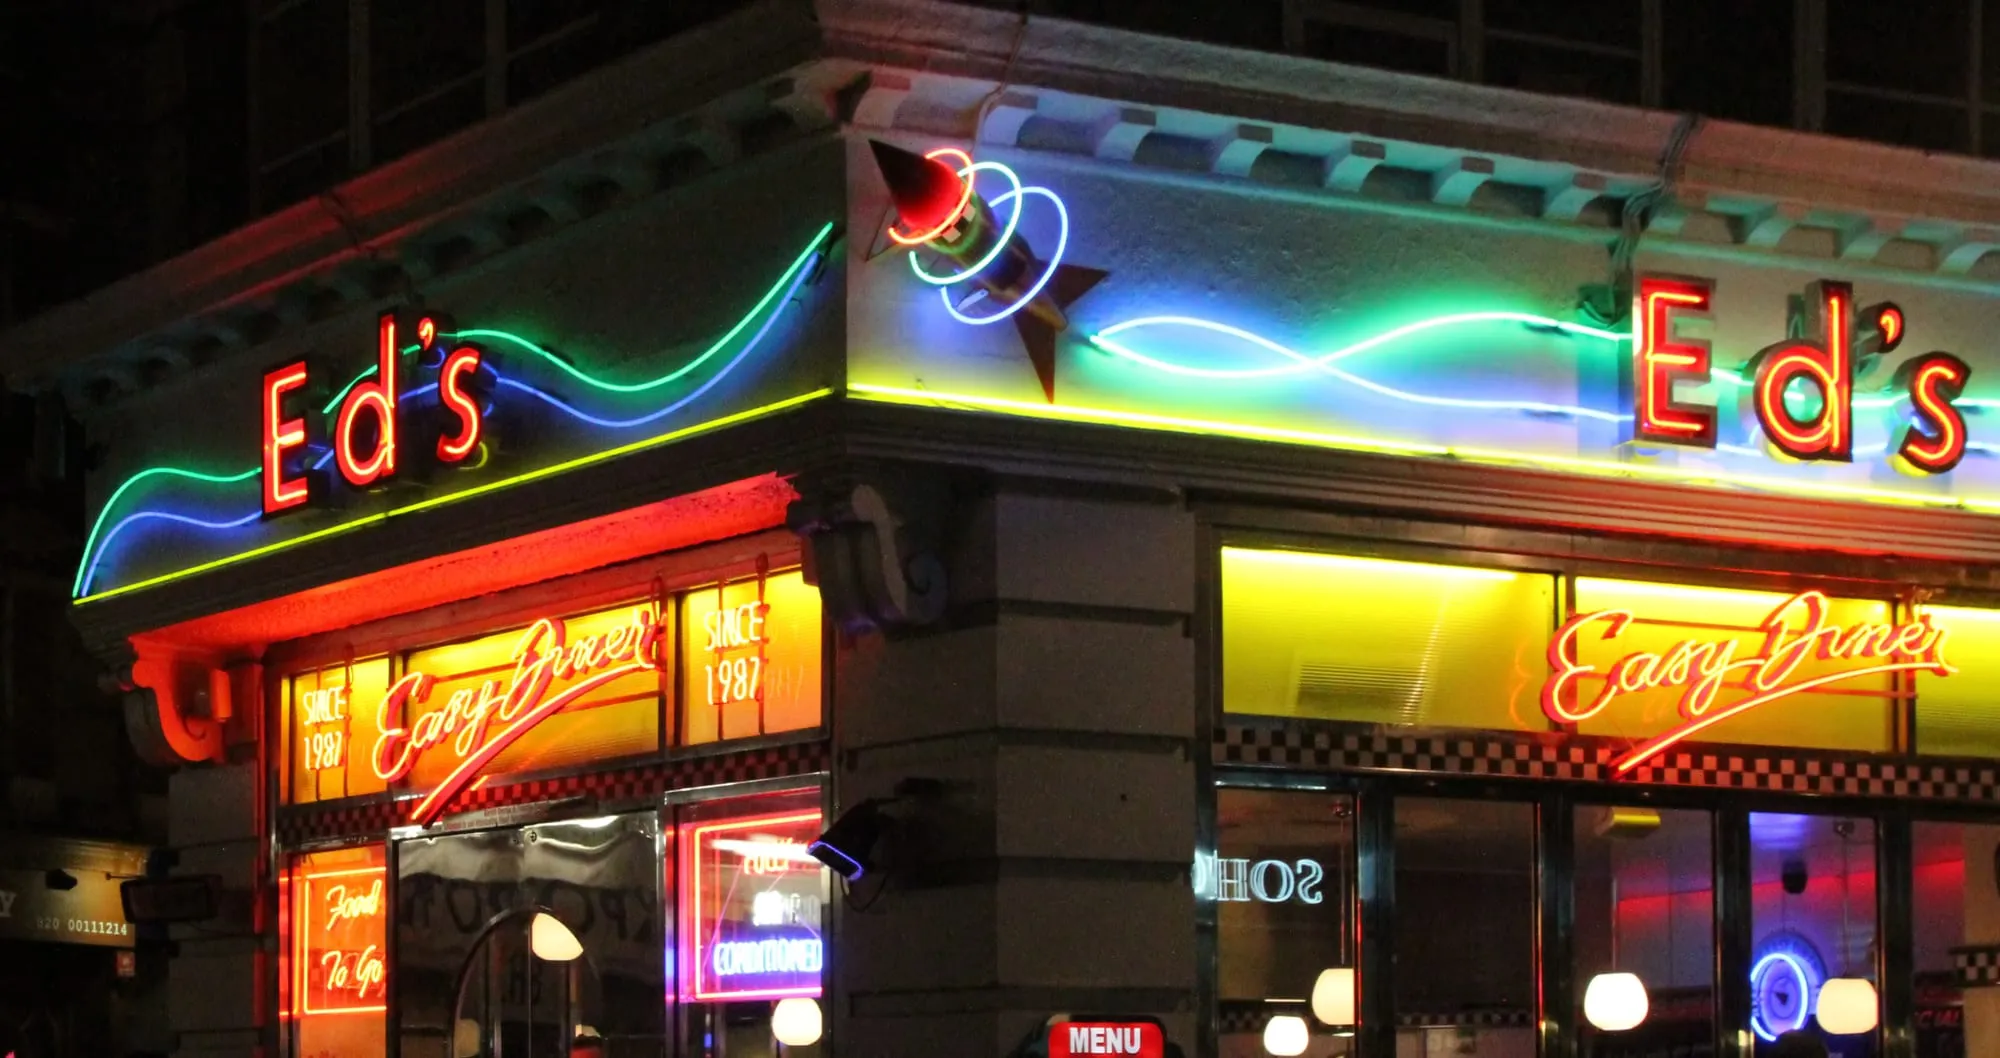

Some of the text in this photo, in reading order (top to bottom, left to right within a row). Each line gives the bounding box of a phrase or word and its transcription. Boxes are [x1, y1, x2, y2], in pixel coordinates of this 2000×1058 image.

[1636, 278, 1967, 474] Ed's
[263, 312, 481, 515] Ed's
[704, 601, 763, 651] SINCE
[705, 656, 760, 706] 1987
[1542, 590, 1959, 722] Easy Diner
[303, 686, 347, 726] SINCE
[372, 609, 656, 781] Easy Diner
[304, 731, 343, 771] 1987
[68, 919, 128, 936] 00111214
[326, 879, 382, 931] Food
[322, 945, 383, 998] To Go
[1069, 1027, 1142, 1054] MENU
